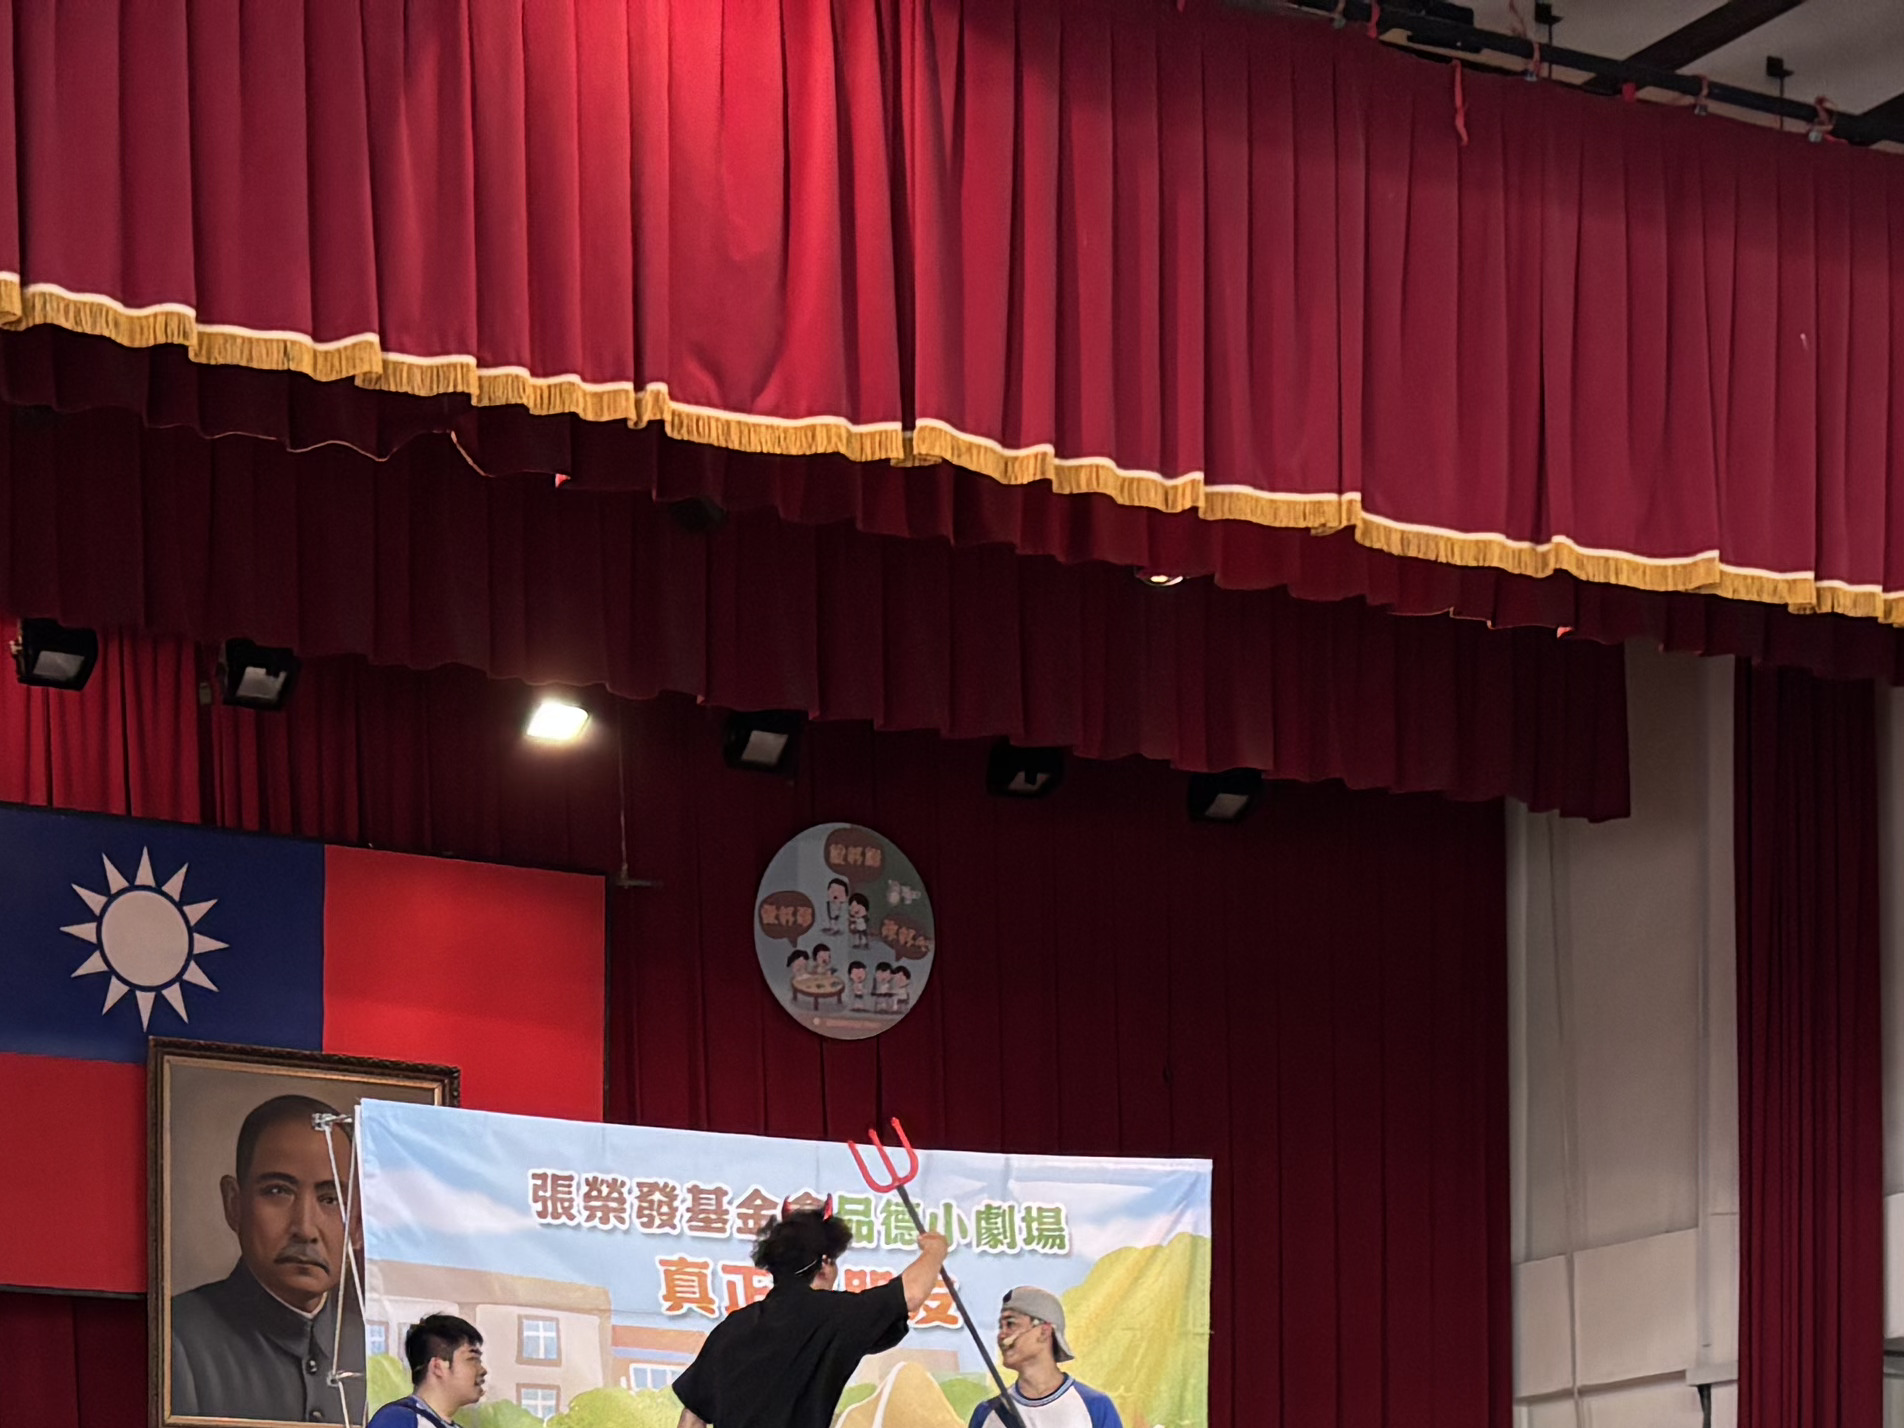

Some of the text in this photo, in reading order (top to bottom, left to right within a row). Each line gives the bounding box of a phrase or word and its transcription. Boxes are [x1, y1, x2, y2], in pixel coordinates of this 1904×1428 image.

[530, 1171, 1068, 1251] 張榮發基金品德小劇場
